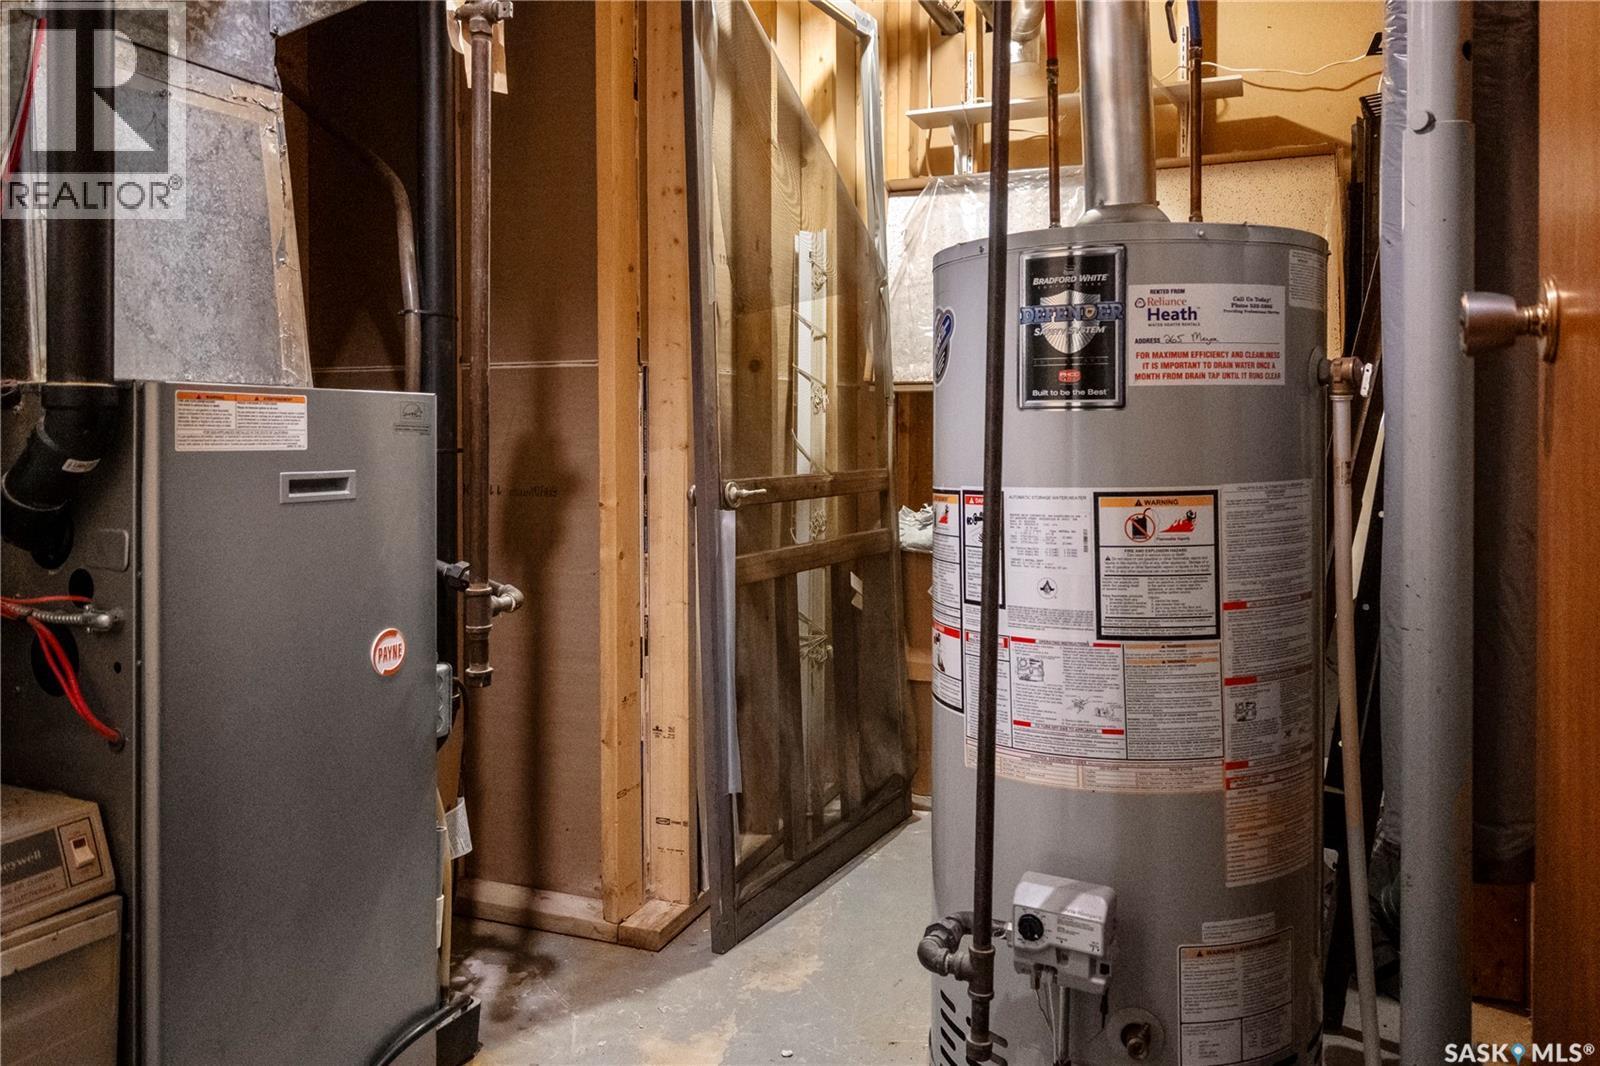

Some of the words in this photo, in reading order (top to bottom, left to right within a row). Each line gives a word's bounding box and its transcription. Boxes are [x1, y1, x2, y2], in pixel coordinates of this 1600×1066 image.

[1033, 275, 1076, 286] BRADFORD
[1079, 273, 1108, 282] WHITE
[1147, 296, 1187, 306] Reliance
[1021, 303, 1123, 323] DEFENDER
[1147, 306, 1197, 321] Heath
[1068, 325, 1106, 335] SYSTEM
[1163, 333, 1184, 344] 265
[1136, 351, 1150, 359] FOR
[1152, 351, 1189, 359] MAXIMUM
[1191, 351, 1229, 359] EFFICIENCY
[1161, 361, 1200, 369] IMPORTANT
[1203, 361, 1212, 369] TO
[1213, 361, 1233, 369] DRAIN
[1235, 361, 1255, 369] WATER
[1256, 361, 1271, 369] ONCE
[1032, 389, 1049, 397] Built
[1072, 388, 1085, 396] the
[1087, 388, 1107, 396] Best
[378, 642, 402, 664] PAYNE
